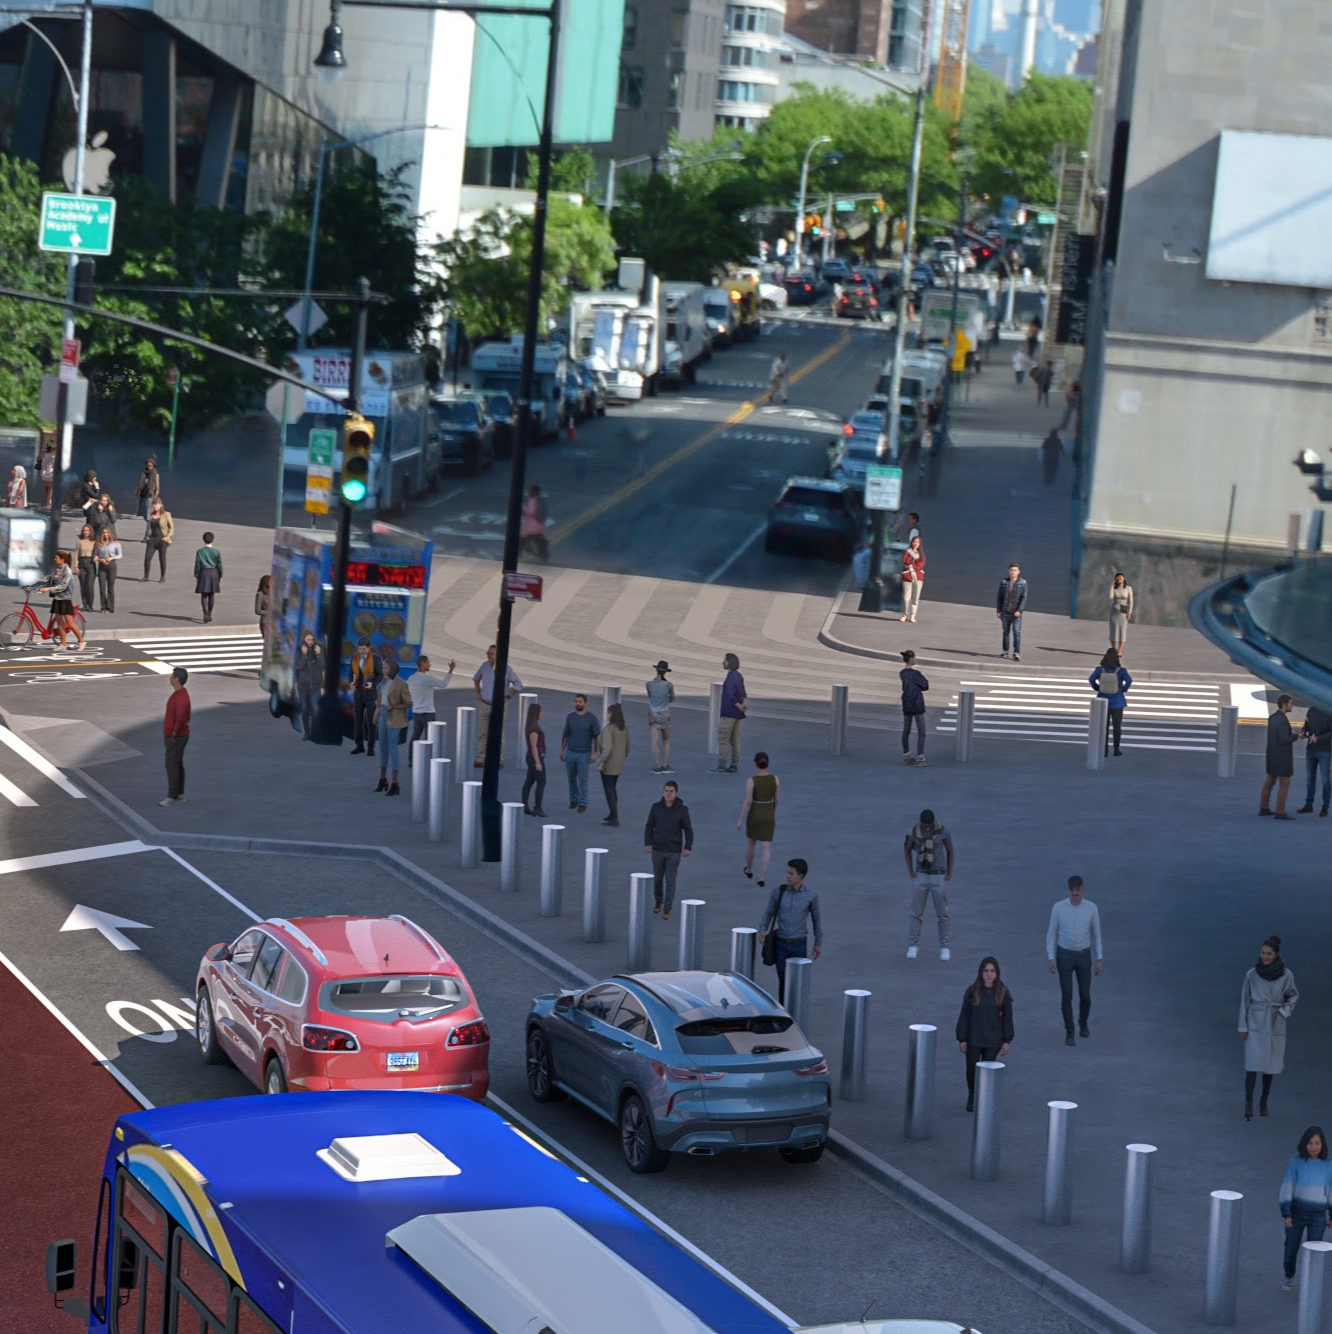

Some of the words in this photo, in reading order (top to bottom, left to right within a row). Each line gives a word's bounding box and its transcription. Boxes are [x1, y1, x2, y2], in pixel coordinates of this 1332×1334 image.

[48, 200, 99, 213] Brooklyn
[48, 211, 93, 224] Academy
[47, 221, 77, 232] Music
[106, 997, 197, 1043] ON
